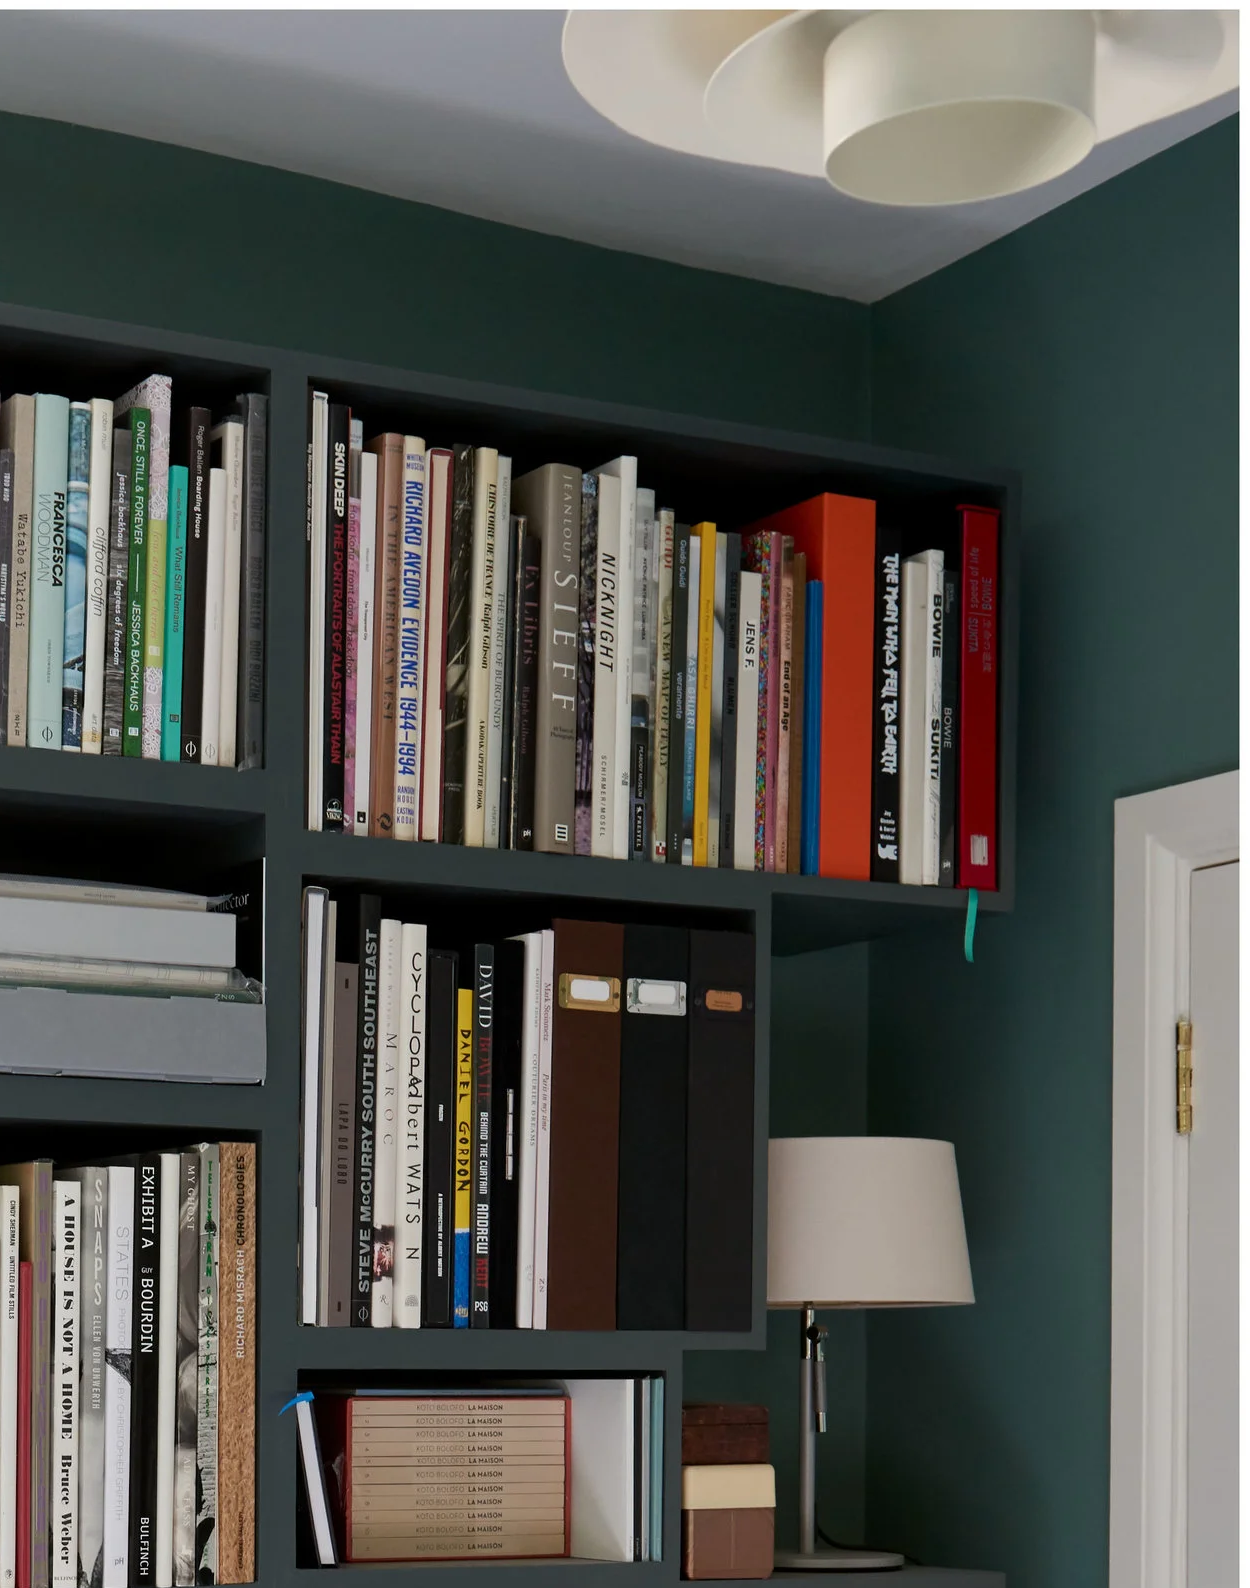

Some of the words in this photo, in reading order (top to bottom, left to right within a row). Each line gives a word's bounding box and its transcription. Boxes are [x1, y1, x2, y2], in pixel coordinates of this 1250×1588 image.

[133, 421, 146, 453] ONCE,
[196, 425, 205, 448] Roger
[334, 442, 346, 477] SKIN
[134, 455, 145, 483] STILL
[196, 450, 205, 474] Ballen
[134, 485, 145, 493] &
[193, 476, 204, 511] Boarding
[333, 478, 345, 517] DEEP
[404, 481, 424, 546] RICHARD
[16, 513, 28, 565] Watabe
[36, 493, 51, 582] WOODMAN
[52, 492, 65, 587] FRANCESCA
[133, 495, 145, 544] FOREVER
[333, 523, 345, 551] THE
[561, 475, 574, 563] JEANLOUP
[93, 527, 108, 575] clifford
[884, 553, 899, 584] THE
[15, 571, 27, 628] Yukichi
[92, 579, 107, 617] coffin
[332, 552, 344, 630] PORTRAITS
[402, 552, 422, 609] AVEDON
[884, 586, 898, 624] MAN
[130, 600, 141, 647] JESSICA
[332, 630, 343, 652] OF
[550, 570, 579, 713] SIEFF
[745, 621, 756, 654] JENS
[884, 625, 898, 666] WHO
[400, 618, 421, 689] EVIDENCE
[744, 659, 756, 669] F.
[130, 650, 141, 711] BACKHAUS
[331, 654, 343, 721] ALASTAIR
[881, 700, 897, 723] TO
[943, 707, 952, 748] BOWIE
[330, 723, 342, 764] THAIN
[881, 725, 898, 775] EARTH
[362, 929, 379, 1050] SOUTHEAST
[478, 964, 493, 1028] DAVID
[361, 1055, 377, 1123] SOUTH
[458, 1029, 472, 1104] DANIEL
[478, 1037, 492, 1104] BOWIE
[479, 1112, 489, 1140] BEHIND
[479, 1143, 488, 1158] THE
[359, 1126, 375, 1222] McCURRY
[456, 1121, 471, 1192] GORDON
[479, 1160, 488, 1194] CURTAIN
[64, 1195, 75, 1207] A
[141, 1166, 155, 1232] EXHIBIT
[235, 1155, 246, 1246] CHRONOLOGIES
[63, 1215, 75, 1281] HOUSE
[142, 1237, 154, 1248] A
[476, 1204, 490, 1254] ANDREW
[235, 1249, 245, 1302] MISRACH
[358, 1229, 373, 1294] STEVE
[476, 1258, 488, 1288] KENT
[63, 1290, 75, 1310] IS
[140, 1278, 154, 1353] BOURDIN
[62, 1317, 74, 1355] NOT
[235, 1306, 245, 1358] RICHARD
[62, 1362, 73, 1374] A
[61, 1383, 73, 1440] HOME
[61, 1455, 73, 1504] Bruce
[60, 1512, 72, 1565] Weber
[139, 1517, 150, 1575] BULFINCH
[477, 1542, 503, 1550] MAISON
